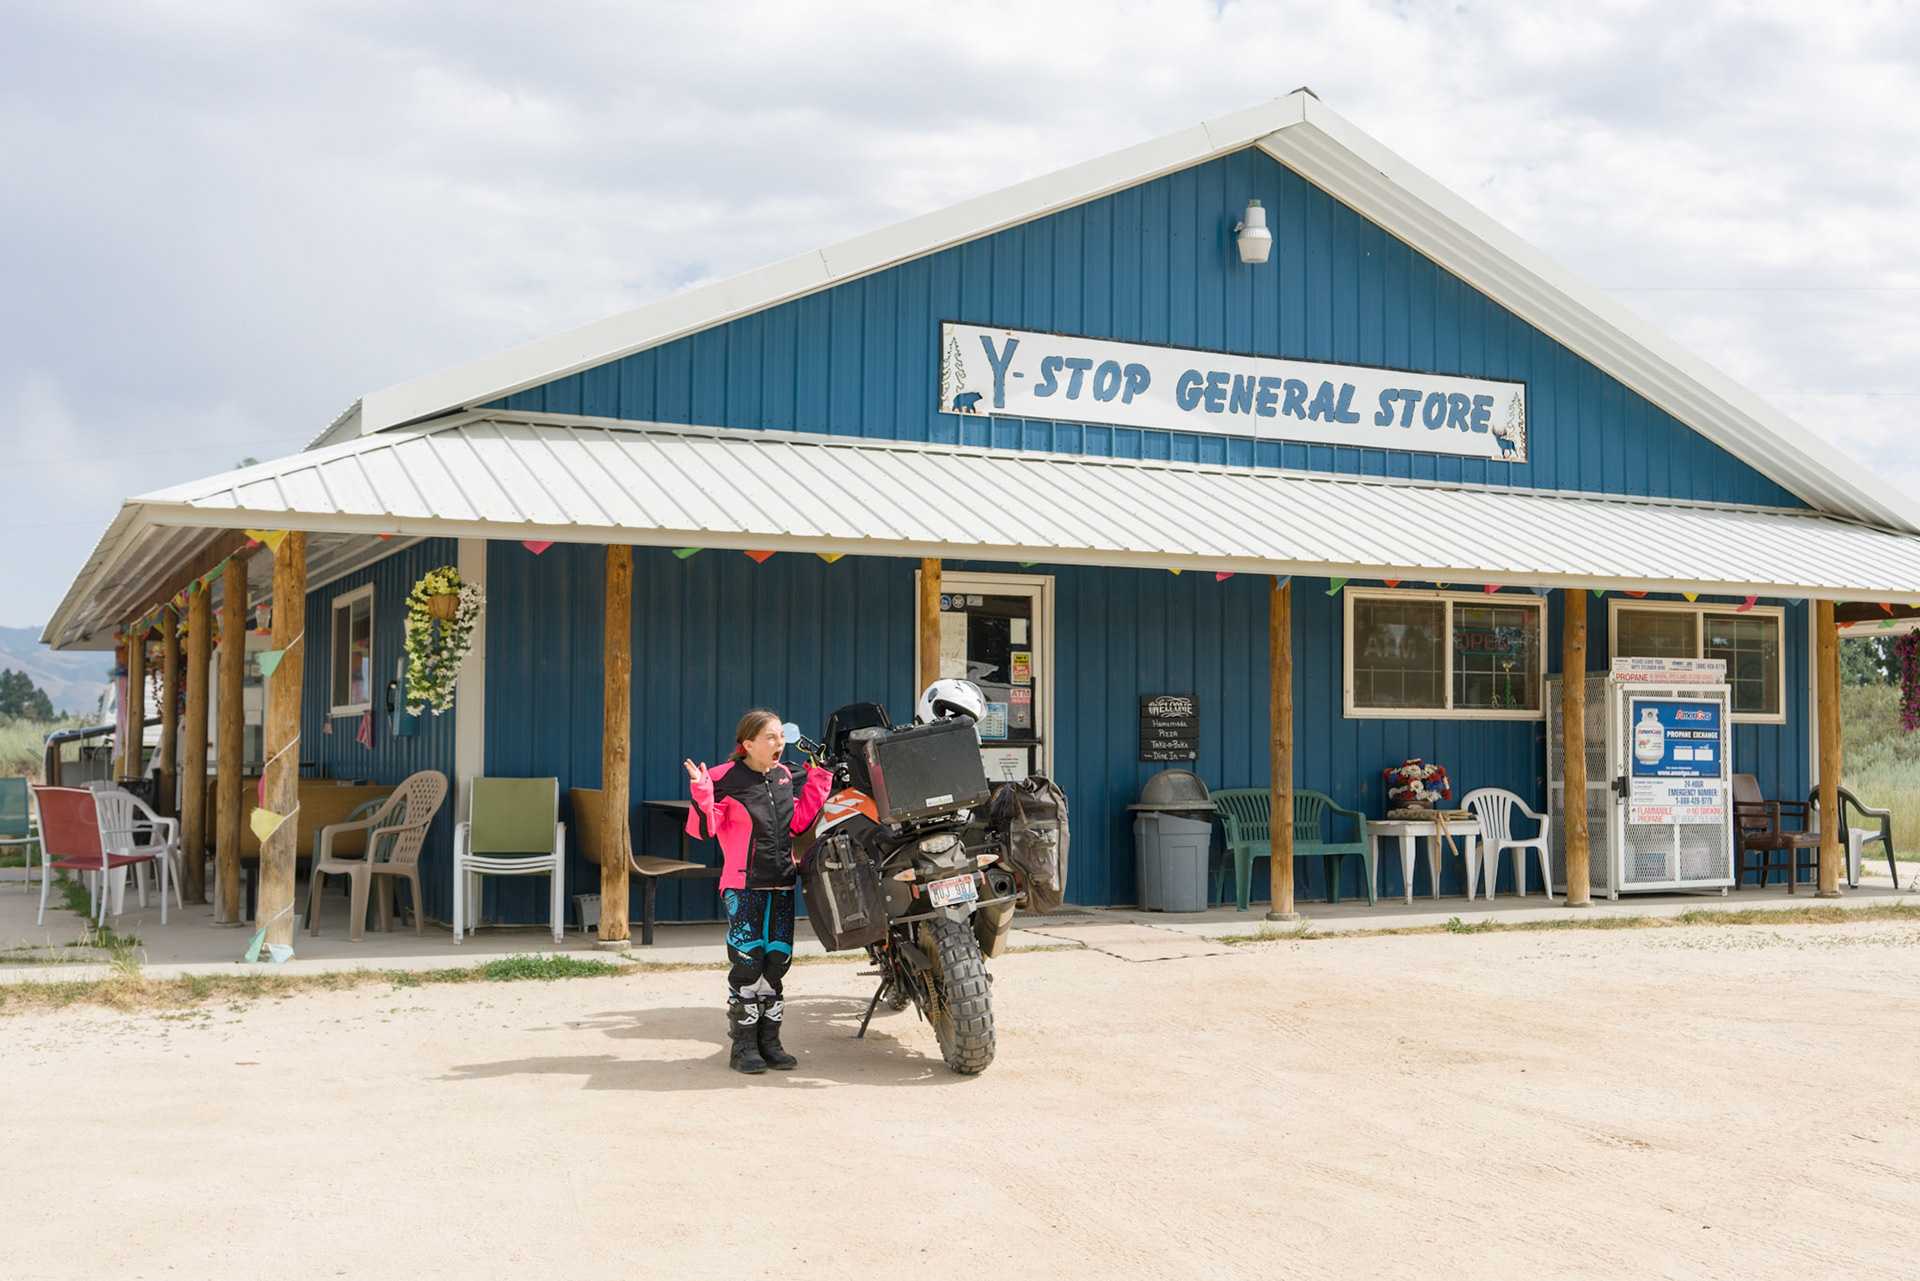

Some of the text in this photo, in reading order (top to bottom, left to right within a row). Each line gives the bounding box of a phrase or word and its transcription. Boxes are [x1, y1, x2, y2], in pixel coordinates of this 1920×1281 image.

[1034, 355, 1151, 405] STOP
[1176, 369, 1360, 424] GENERAL
[1374, 388, 1495, 434] STORE
[1454, 632, 1510, 651] OPEN
[1615, 673, 1648, 681] PROPANE
[1148, 699, 1193, 716] WELCOME
[1675, 710, 1712, 720] AmeriGas
[1667, 730, 1718, 739] PROPANE EXCHANGE
[1684, 780, 1704, 788] 24-HOUR
[1668, 788, 1696, 796] EMERGENCY
[1637, 807, 1722, 815] FLAMMABLE NO SMOKING
[1637, 815, 1663, 823] PROPANE
[955, 881, 971, 896] 987
